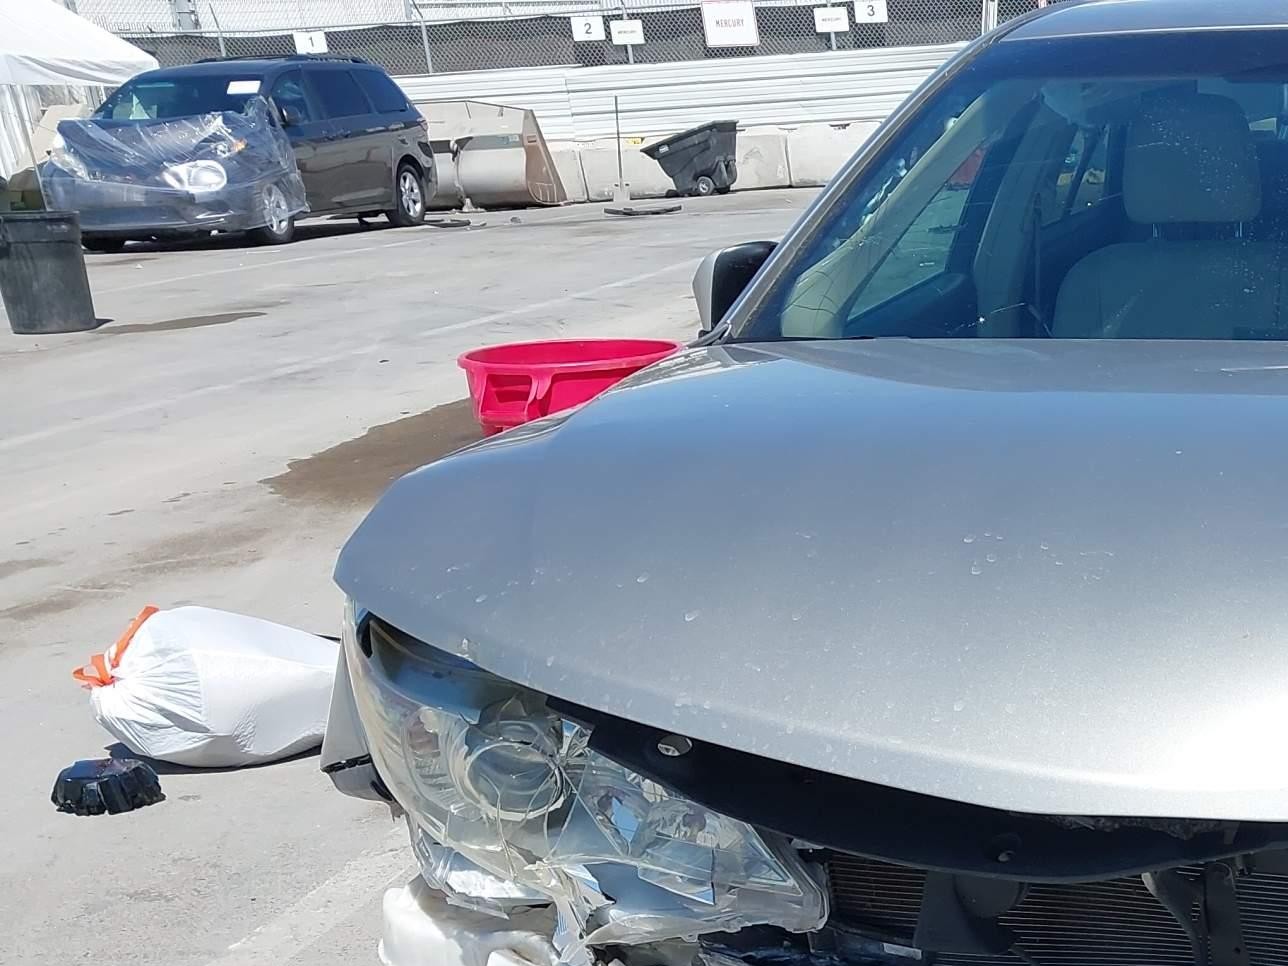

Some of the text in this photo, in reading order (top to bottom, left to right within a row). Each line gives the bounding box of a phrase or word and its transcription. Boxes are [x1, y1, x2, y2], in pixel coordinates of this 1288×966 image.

[867, 5, 875, 16] 3
[583, 23, 592, 34] 2
[715, 18, 745, 28] MERCURY
[308, 36, 315, 47] 1
